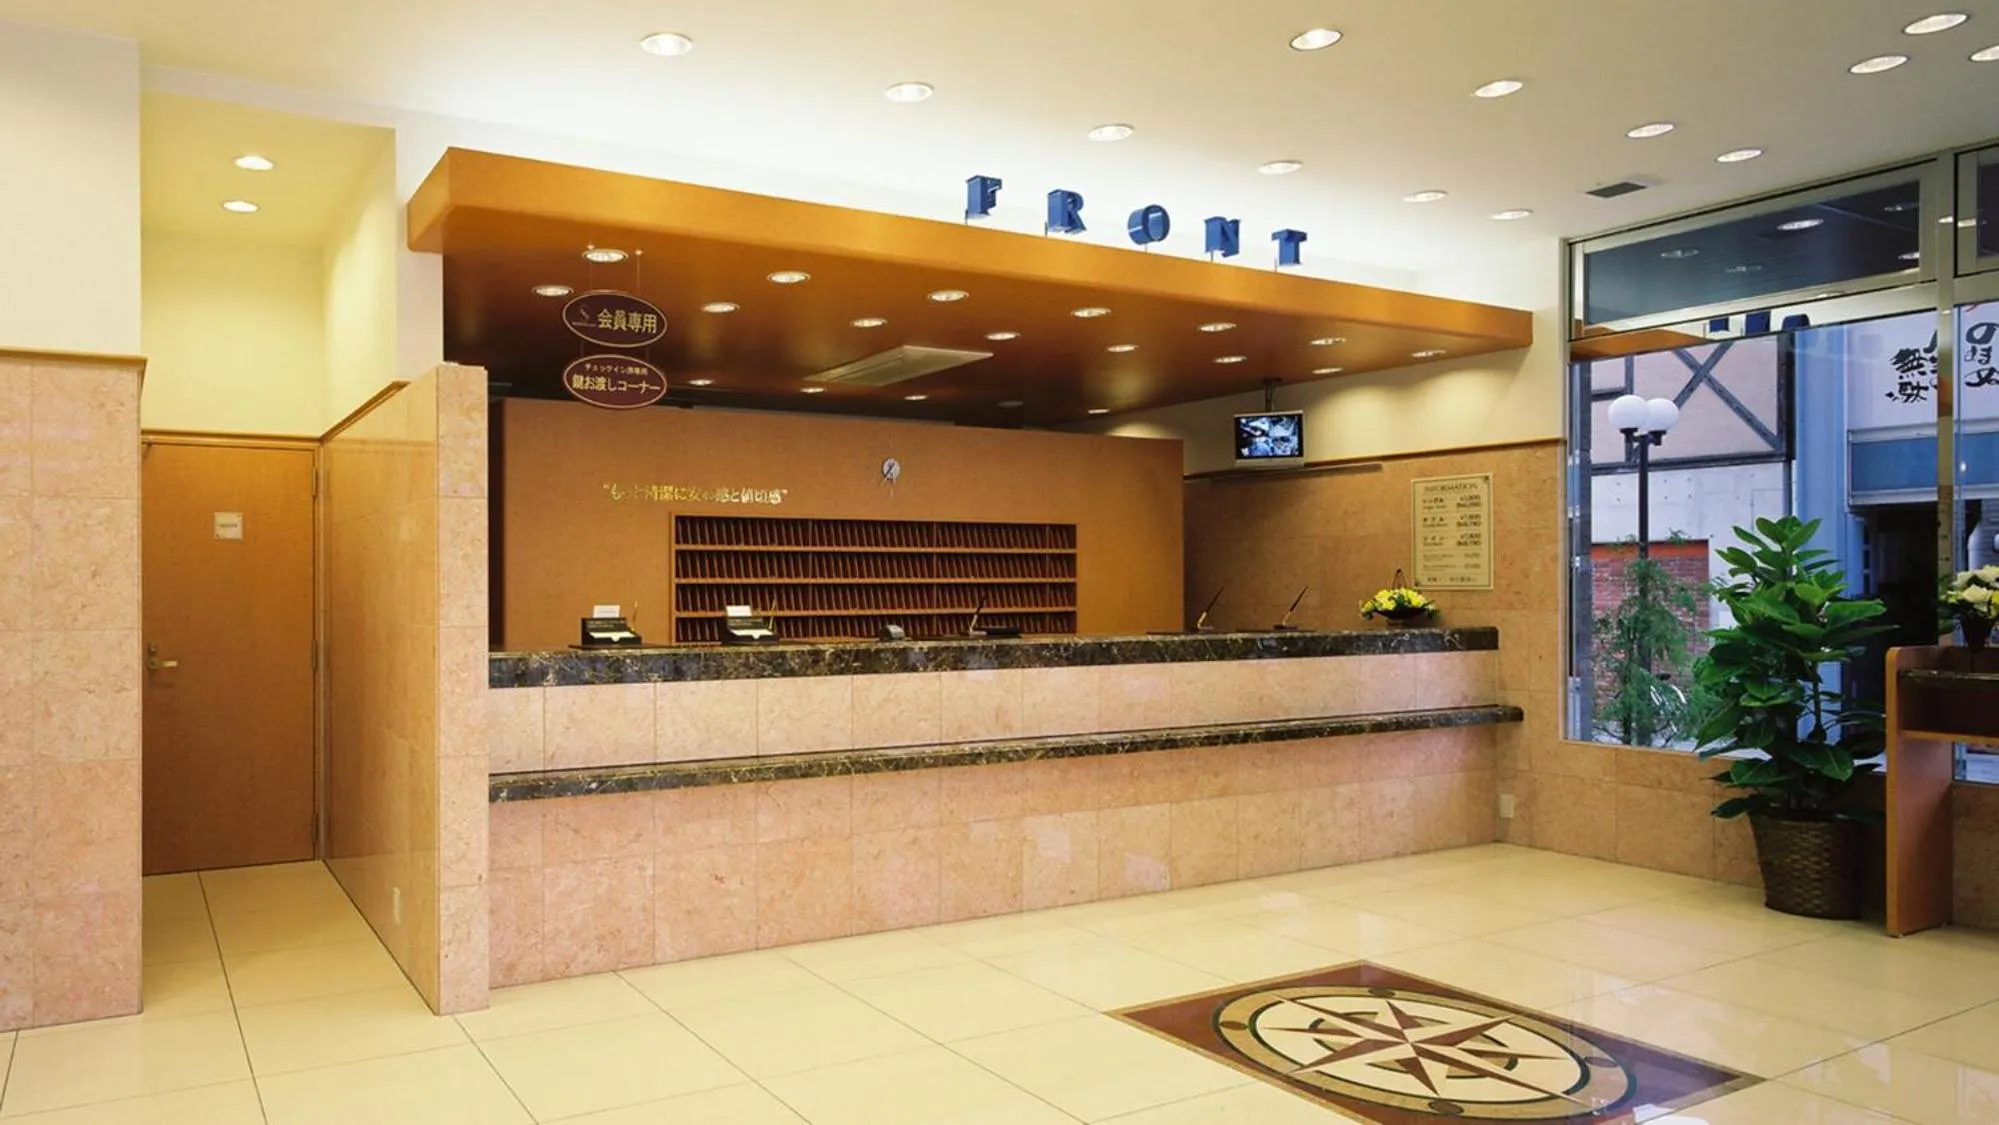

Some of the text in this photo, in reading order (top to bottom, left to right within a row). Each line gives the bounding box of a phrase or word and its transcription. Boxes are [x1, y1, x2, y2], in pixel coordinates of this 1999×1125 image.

[965, 175, 1308, 267] FRONT
[598, 308, 657, 334] 会員専用
[572, 374, 661, 394] 鍵お渡しコーナー
